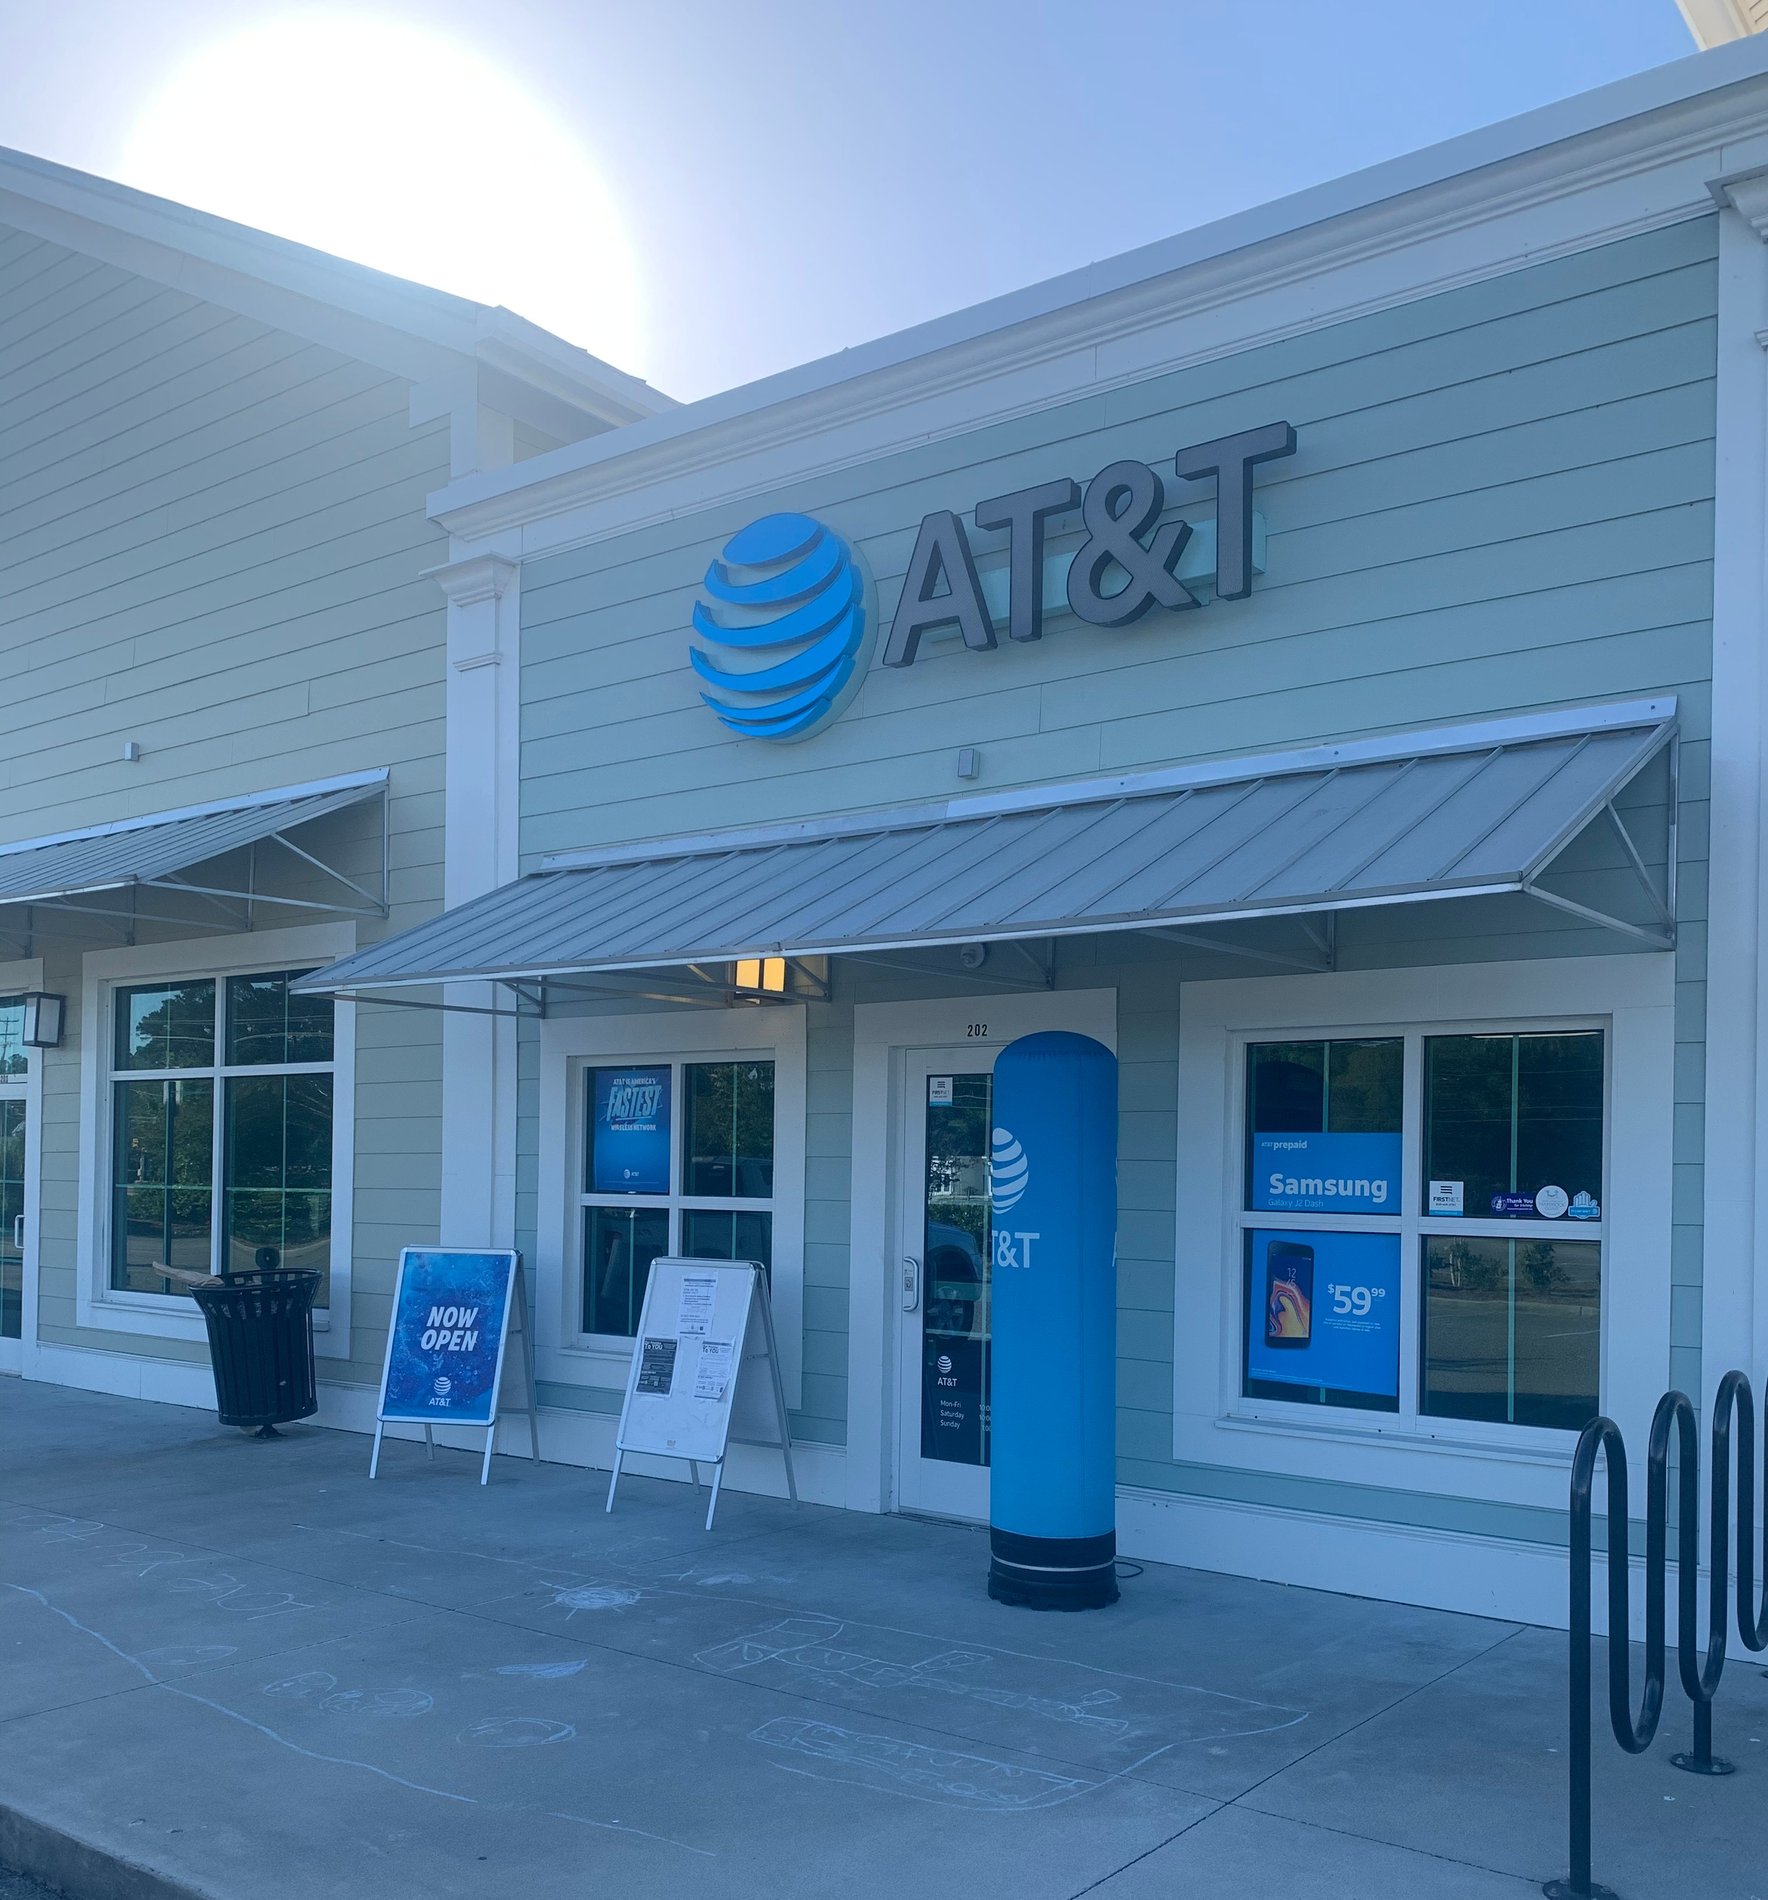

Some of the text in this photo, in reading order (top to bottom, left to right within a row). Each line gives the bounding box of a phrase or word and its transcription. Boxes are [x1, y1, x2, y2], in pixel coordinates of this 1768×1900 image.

[882, 421, 1297, 668] AT&T
[967, 1023, 988, 1037] 202
[606, 1085, 662, 1121] FASTEST
[1273, 1140, 1308, 1151] prepaid
[1269, 1173, 1388, 1203] Samsung
[1268, 1199, 1293, 1209] Galaxy
[1304, 1200, 1324, 1208] Dash
[992, 1230, 1040, 1269] T&T
[1287, 1267, 1297, 1279] 12
[426, 1306, 479, 1328] NOW
[420, 1329, 479, 1352] OPEN
[937, 1376, 958, 1387] AT&T
[428, 1397, 451, 1407] AT&T
[940, 1399, 962, 1408] Mon-Fri
[940, 1409, 965, 1421] Saturday
[940, 1419, 961, 1430] Sunday
